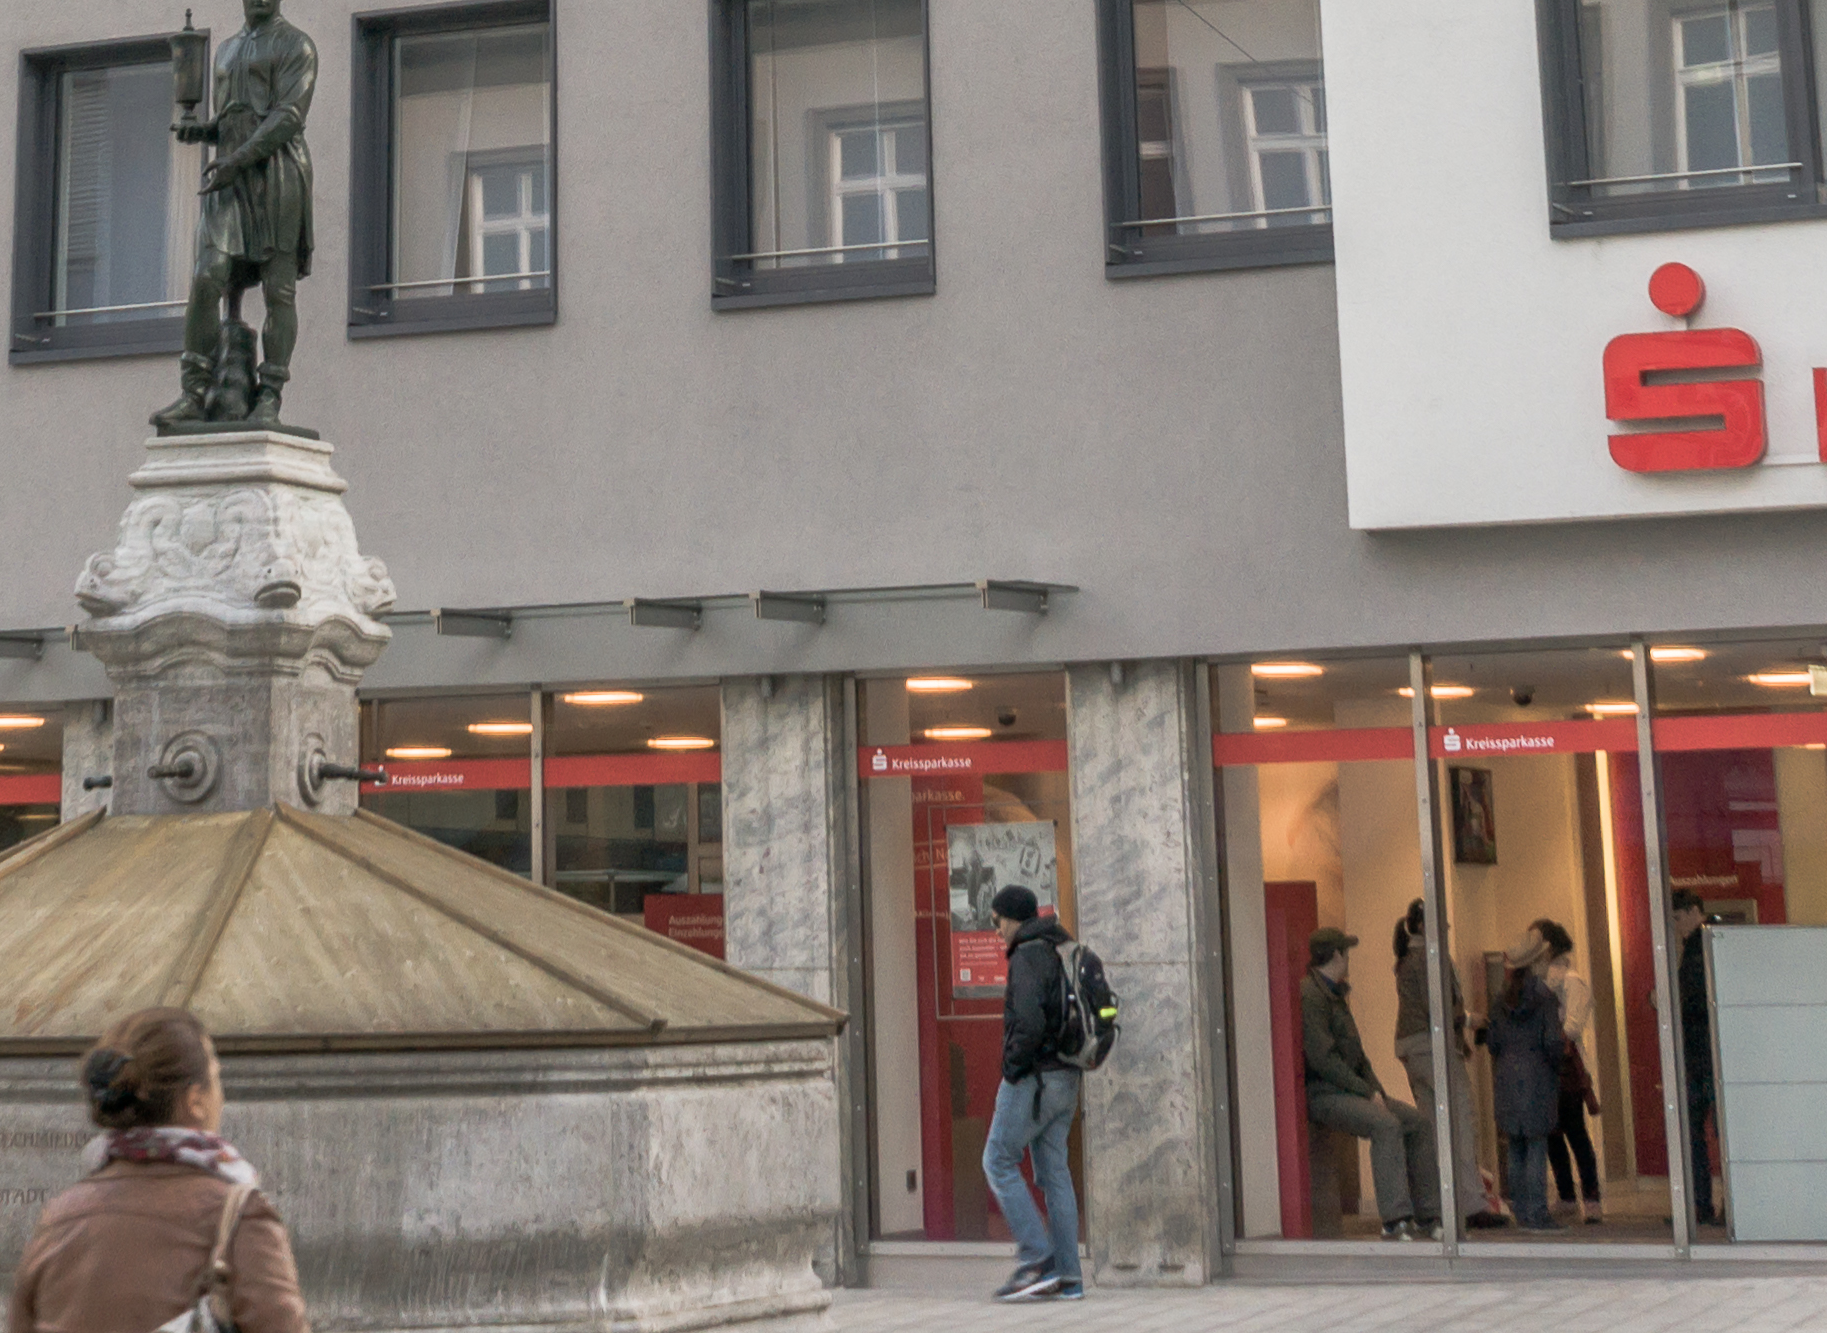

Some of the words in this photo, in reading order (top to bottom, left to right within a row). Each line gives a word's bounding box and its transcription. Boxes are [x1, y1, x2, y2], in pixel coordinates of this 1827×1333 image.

[1465, 734, 1555, 751] Kreissparkasse
[891, 755, 973, 771] Kreissparkasse
[391, 771, 465, 788] Kreissparkasse
